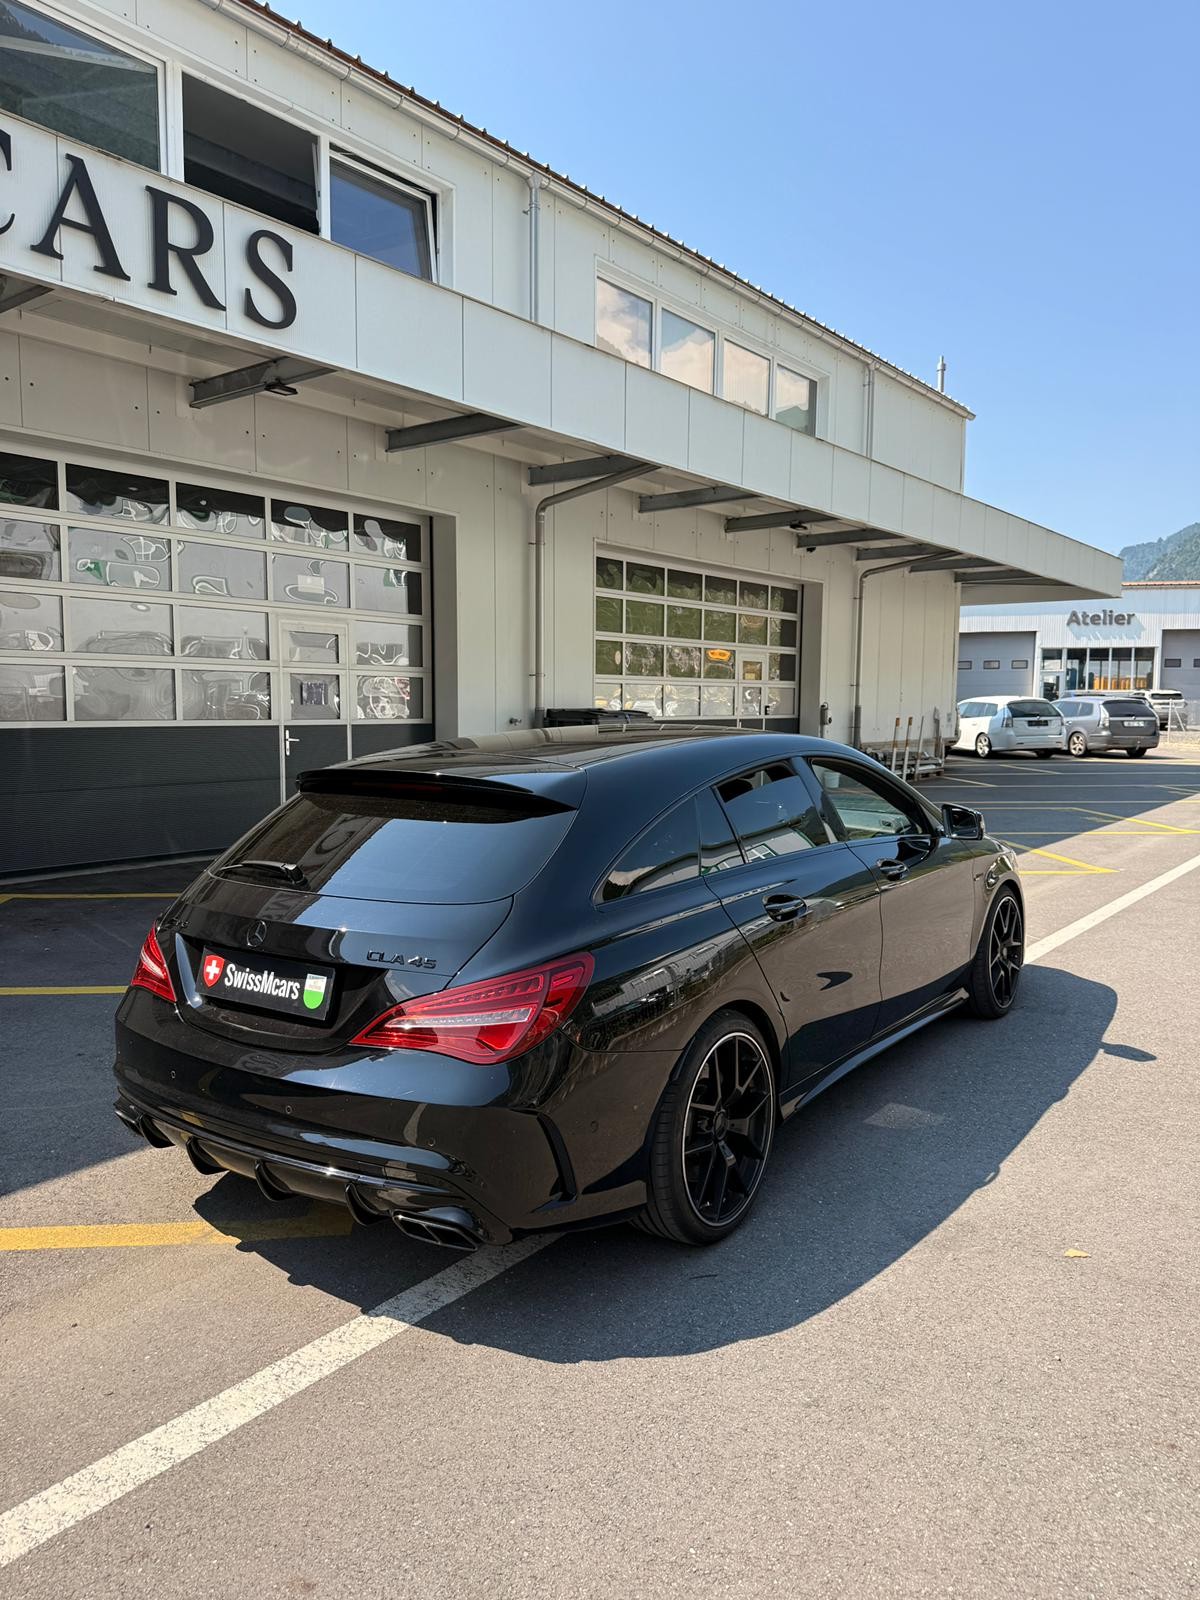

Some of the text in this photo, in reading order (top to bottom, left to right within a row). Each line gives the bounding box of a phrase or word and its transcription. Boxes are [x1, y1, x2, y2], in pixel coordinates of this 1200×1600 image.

[0, 129, 297, 329] ARS
[1066, 610, 1135, 626] Atelier
[366, 950, 437, 970] CLA 45
[224, 963, 301, 1000] SwissMcars
